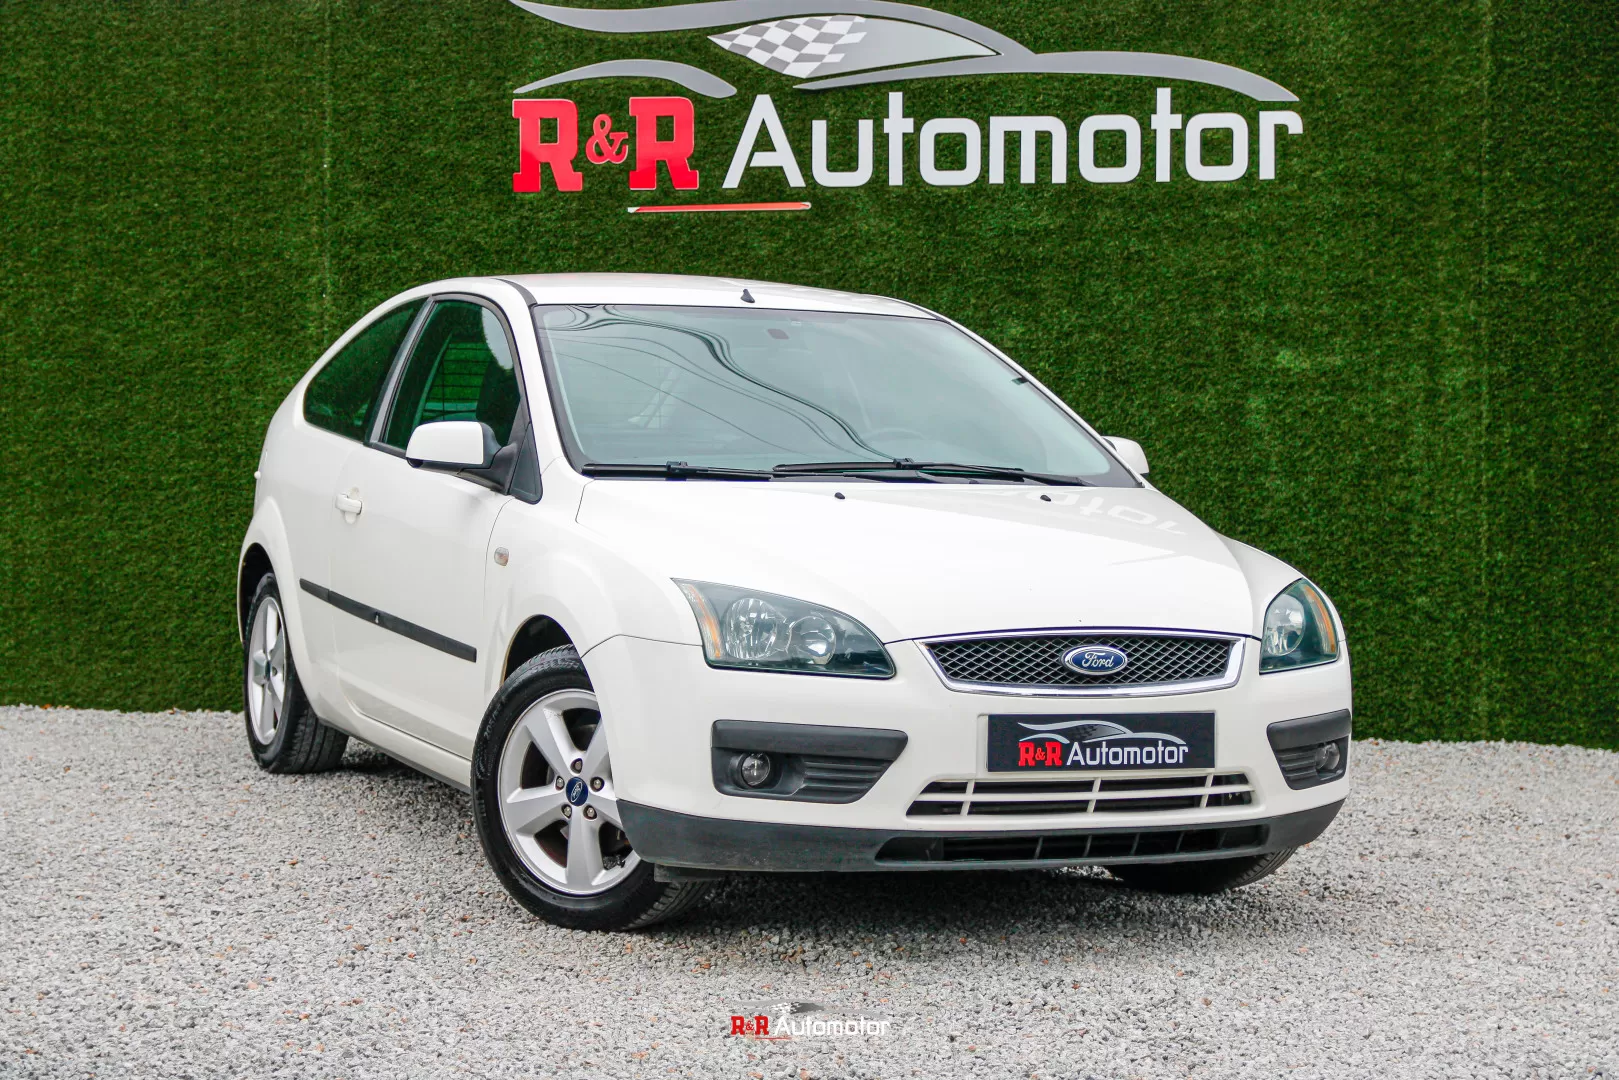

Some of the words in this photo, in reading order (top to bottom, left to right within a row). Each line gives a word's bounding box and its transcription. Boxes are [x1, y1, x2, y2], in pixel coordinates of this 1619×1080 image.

[512, 96, 700, 193] R&R
[722, 86, 1304, 190] Automotor
[1081, 651, 1115, 668] Ford
[1018, 741, 1063, 767] R&R
[1066, 740, 1189, 766] Automotor
